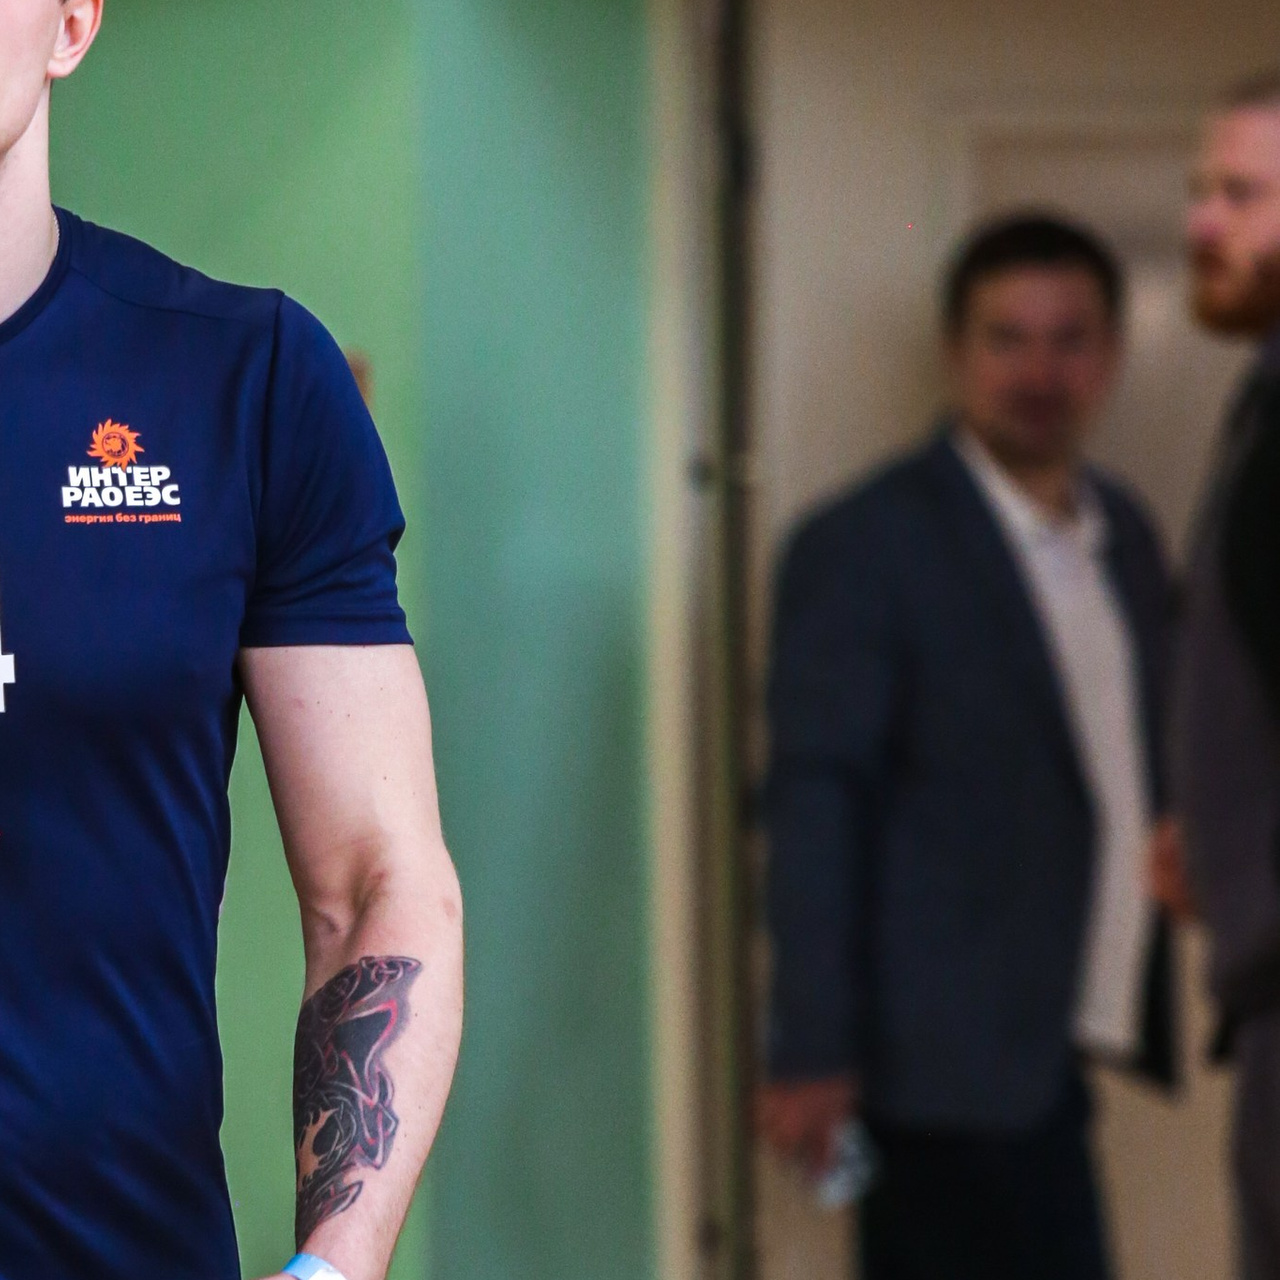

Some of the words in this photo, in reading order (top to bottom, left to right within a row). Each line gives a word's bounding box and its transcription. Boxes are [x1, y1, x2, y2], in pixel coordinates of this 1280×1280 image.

[68, 466, 171, 487] ИНТЕР
[64, 514, 113, 524] энергия
[115, 513, 137, 523] без
[138, 513, 182, 524] границ
